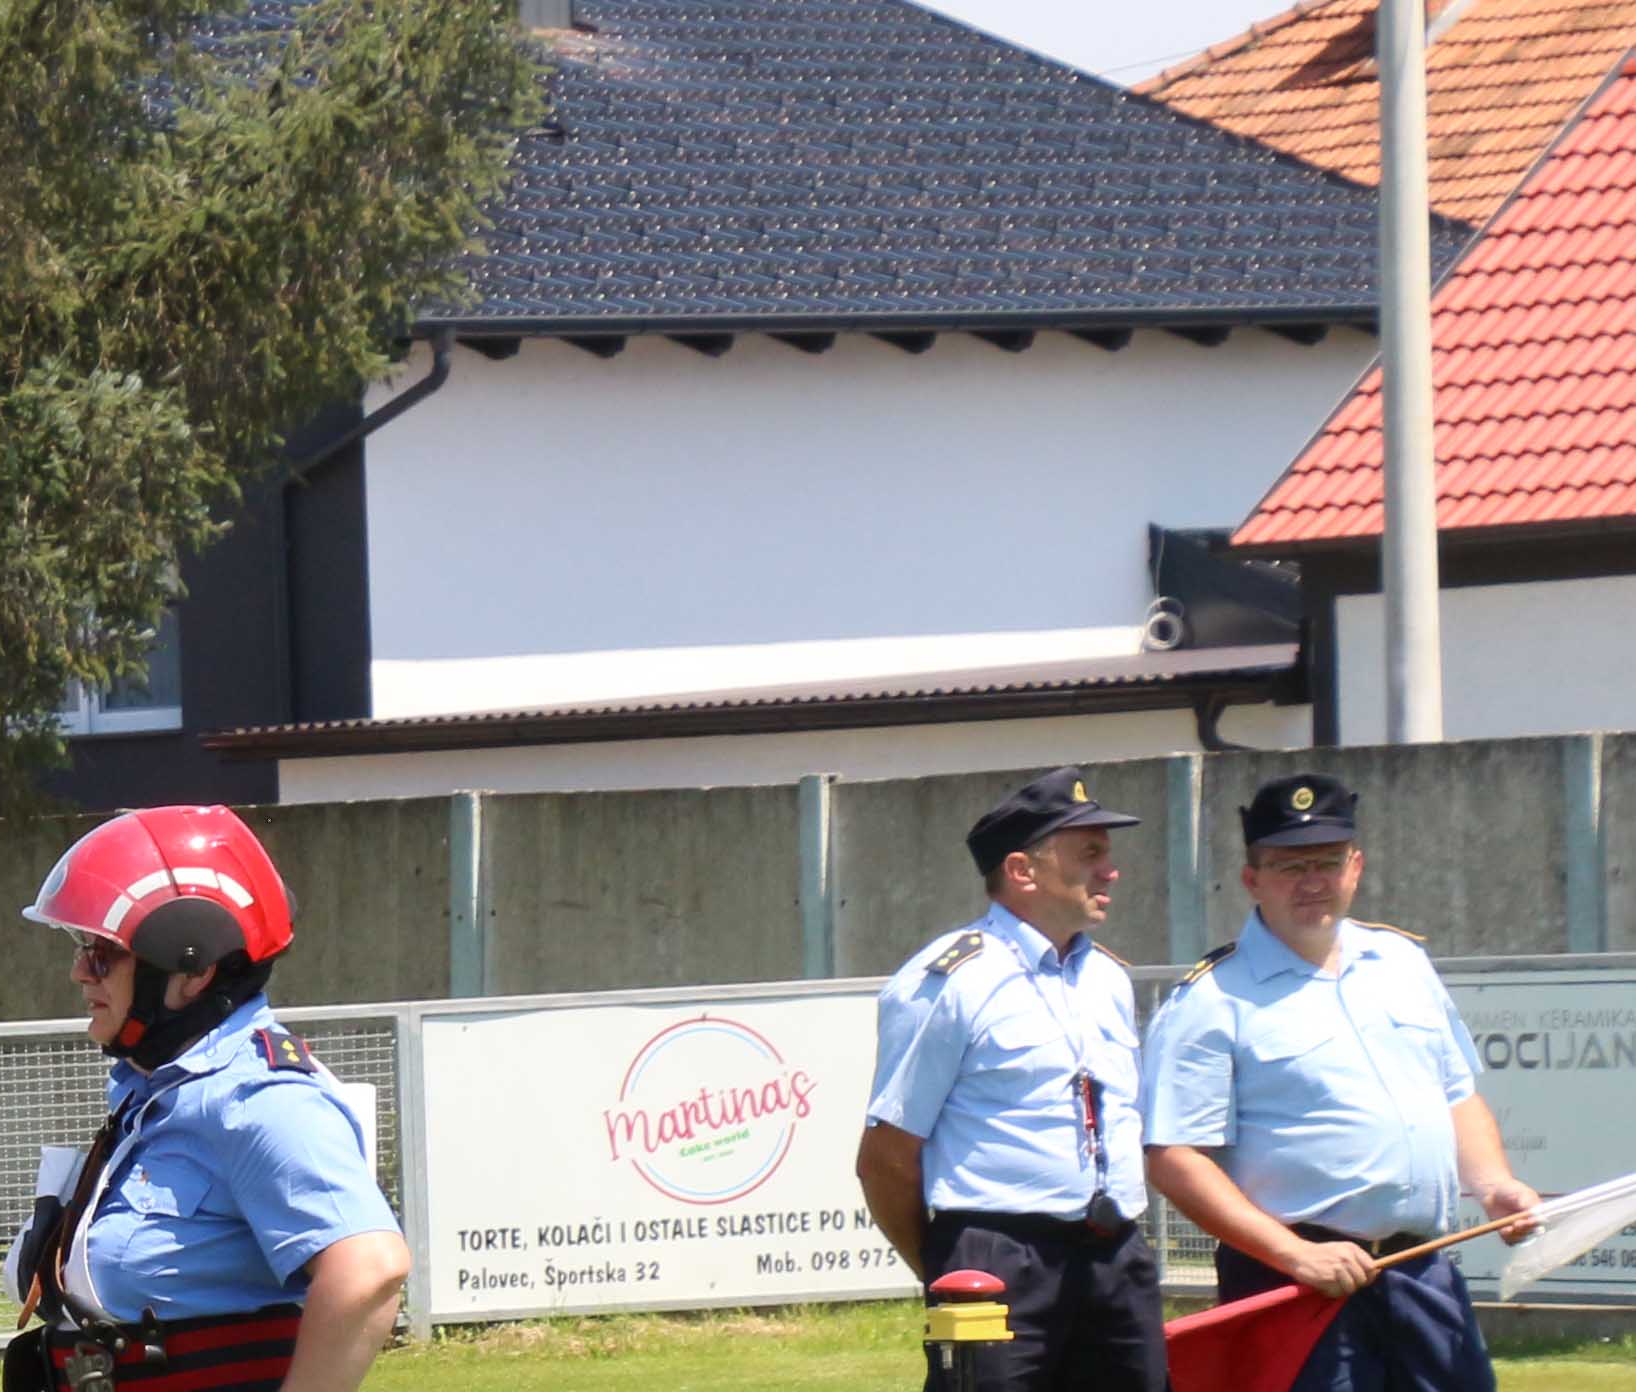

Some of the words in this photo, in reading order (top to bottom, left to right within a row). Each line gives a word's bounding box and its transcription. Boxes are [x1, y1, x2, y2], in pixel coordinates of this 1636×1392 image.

[1472, 1031, 1636, 1071] OCIJAN
[457, 1227, 528, 1253] TORTE,
[537, 1216, 612, 1248] KOLAČI
[620, 1221, 627, 1244] I
[634, 1215, 708, 1243] OSTALE
[716, 1211, 811, 1238] SLASTICE
[820, 1209, 846, 1232] PO
[458, 1267, 536, 1291] Palovec,
[544, 1257, 627, 1292] Športska
[635, 1261, 661, 1282] 32
[756, 1250, 803, 1275] Mob.
[811, 1249, 851, 1272] 098
